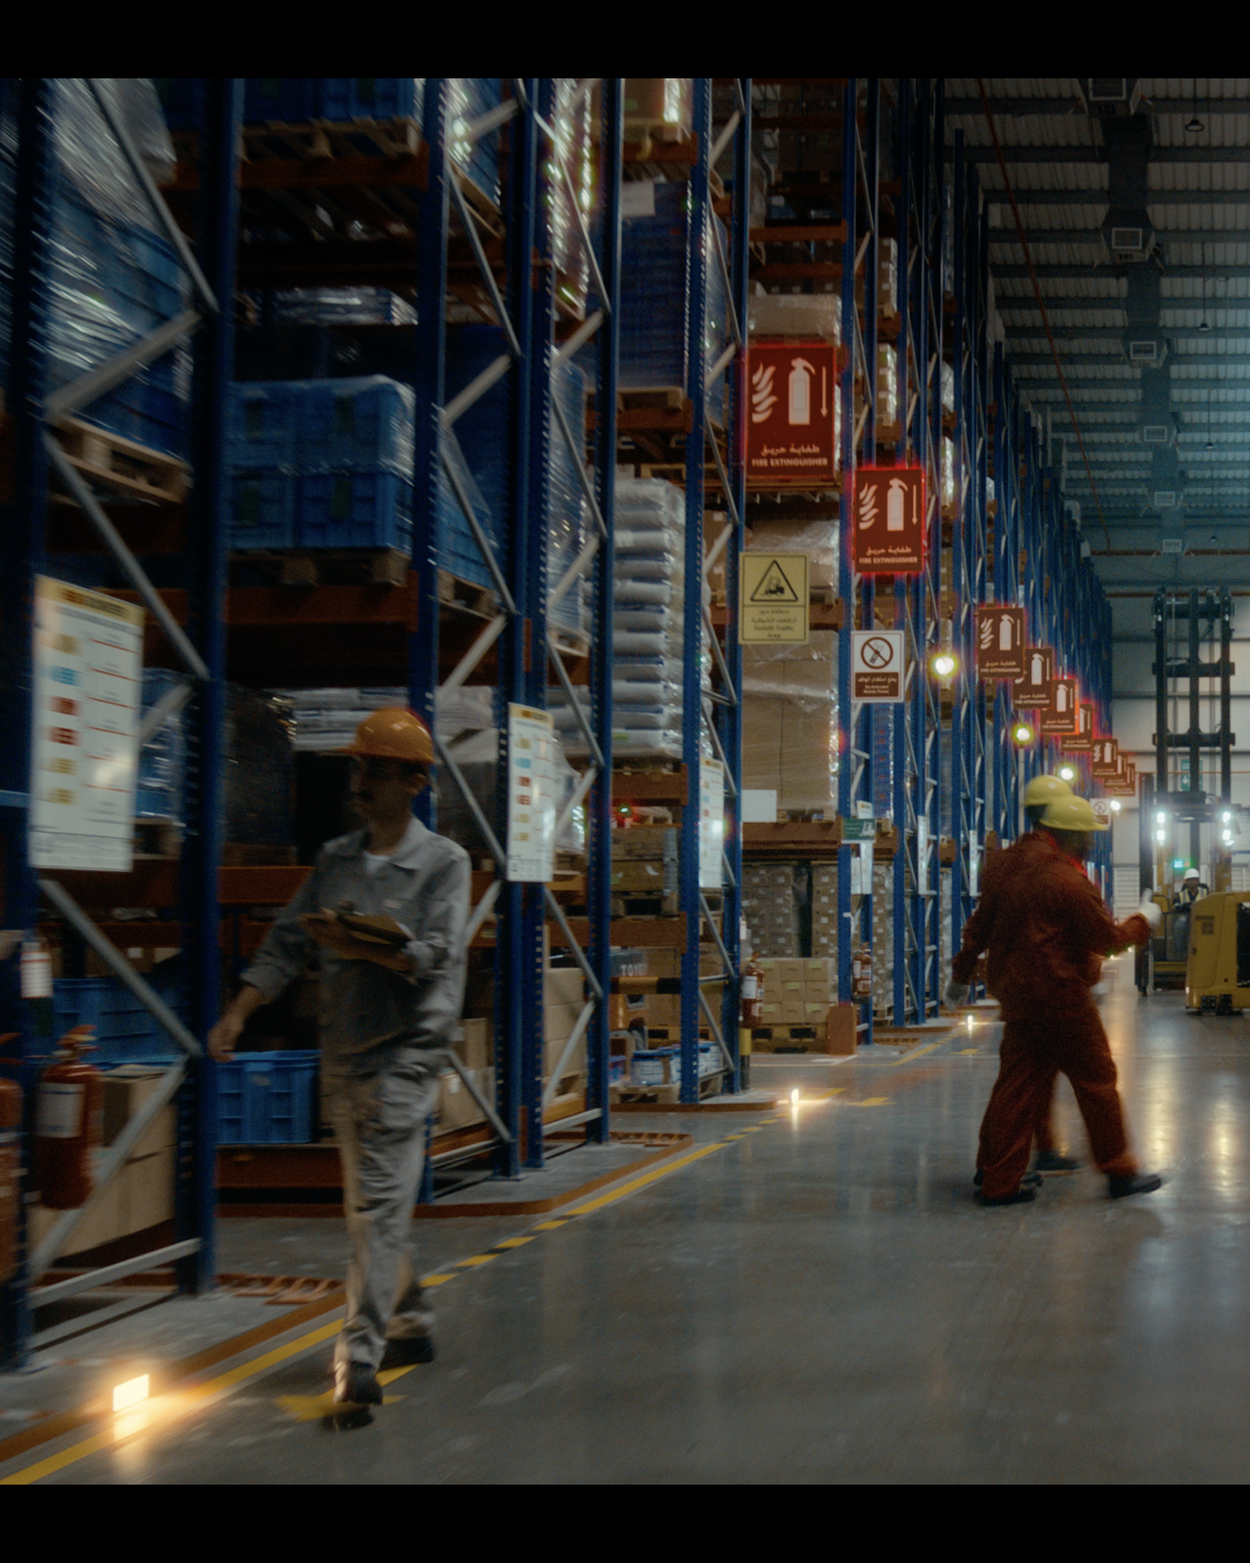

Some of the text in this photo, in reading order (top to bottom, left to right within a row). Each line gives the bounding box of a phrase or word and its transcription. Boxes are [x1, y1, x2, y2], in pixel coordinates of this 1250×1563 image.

[751, 457, 828, 468] FIRE EXTINGUISHER
[873, 556, 918, 564] EXTINGUISHER
